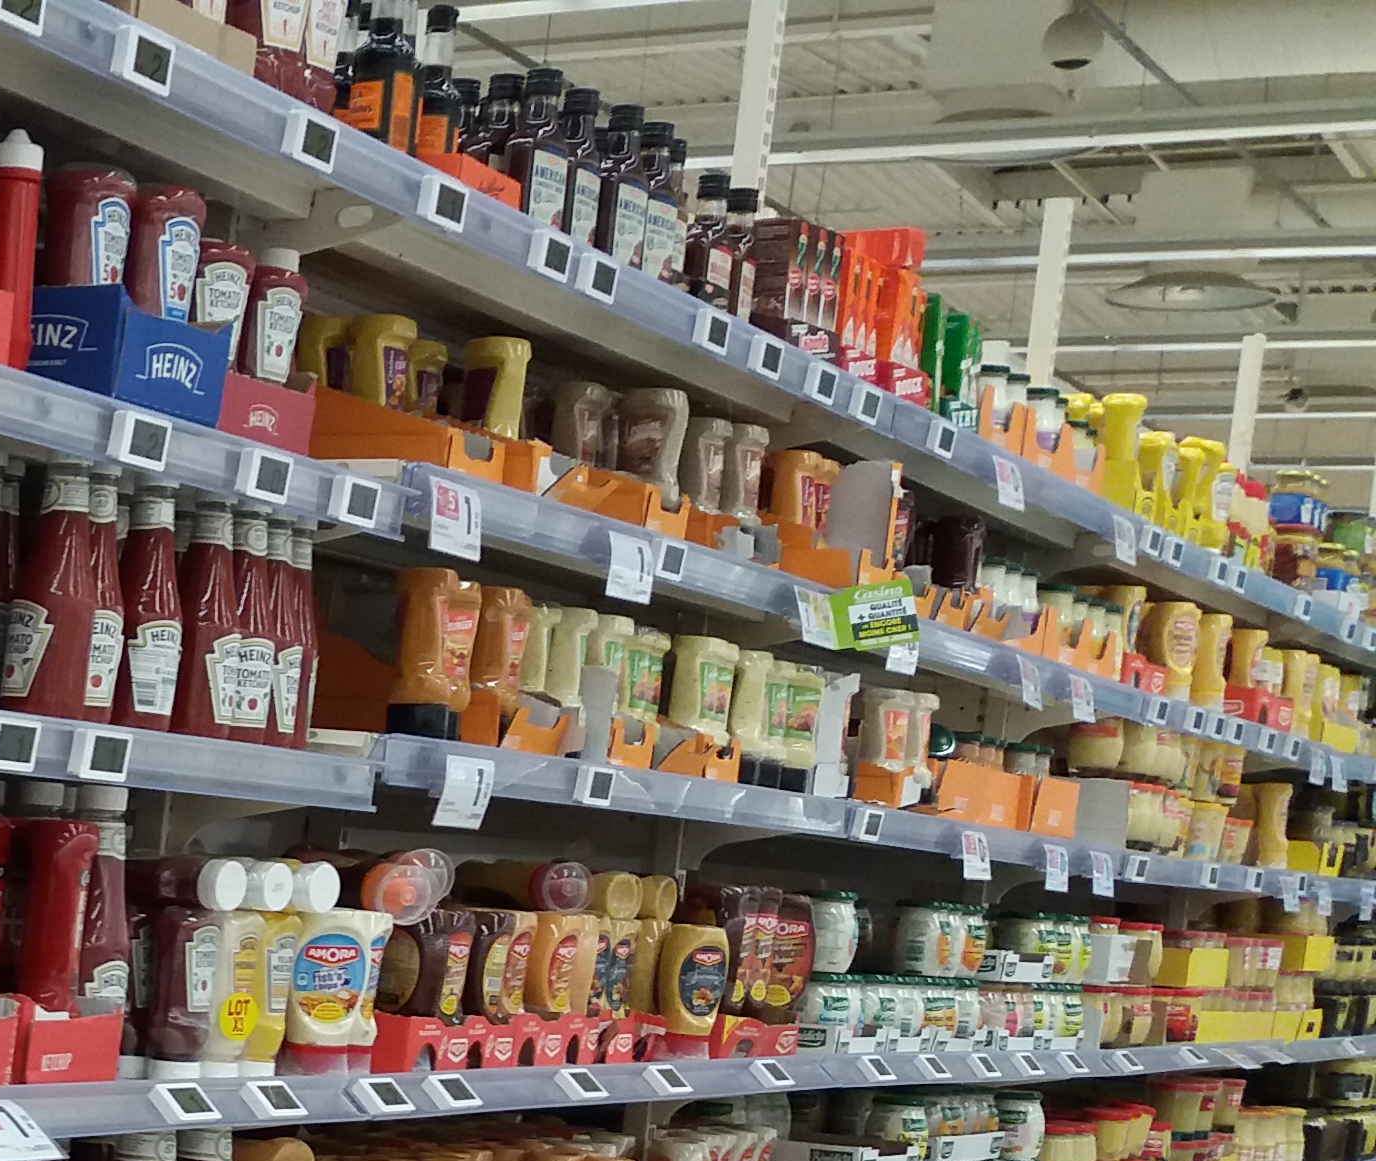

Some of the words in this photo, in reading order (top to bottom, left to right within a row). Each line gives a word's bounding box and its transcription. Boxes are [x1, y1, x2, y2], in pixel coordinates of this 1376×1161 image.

[215, 271, 240, 285] HEINZ
[208, 288, 241, 301] TOMATO
[152, 353, 197, 390] HEINZ
[248, 411, 276, 430] HEINZ
[854, 586, 903, 600] Casino
[240, 650, 272, 663] HEINZ
[237, 667, 270, 679] TOMATO
[308, 948, 355, 962] AMORA
[227, 998, 250, 1018] LOT
